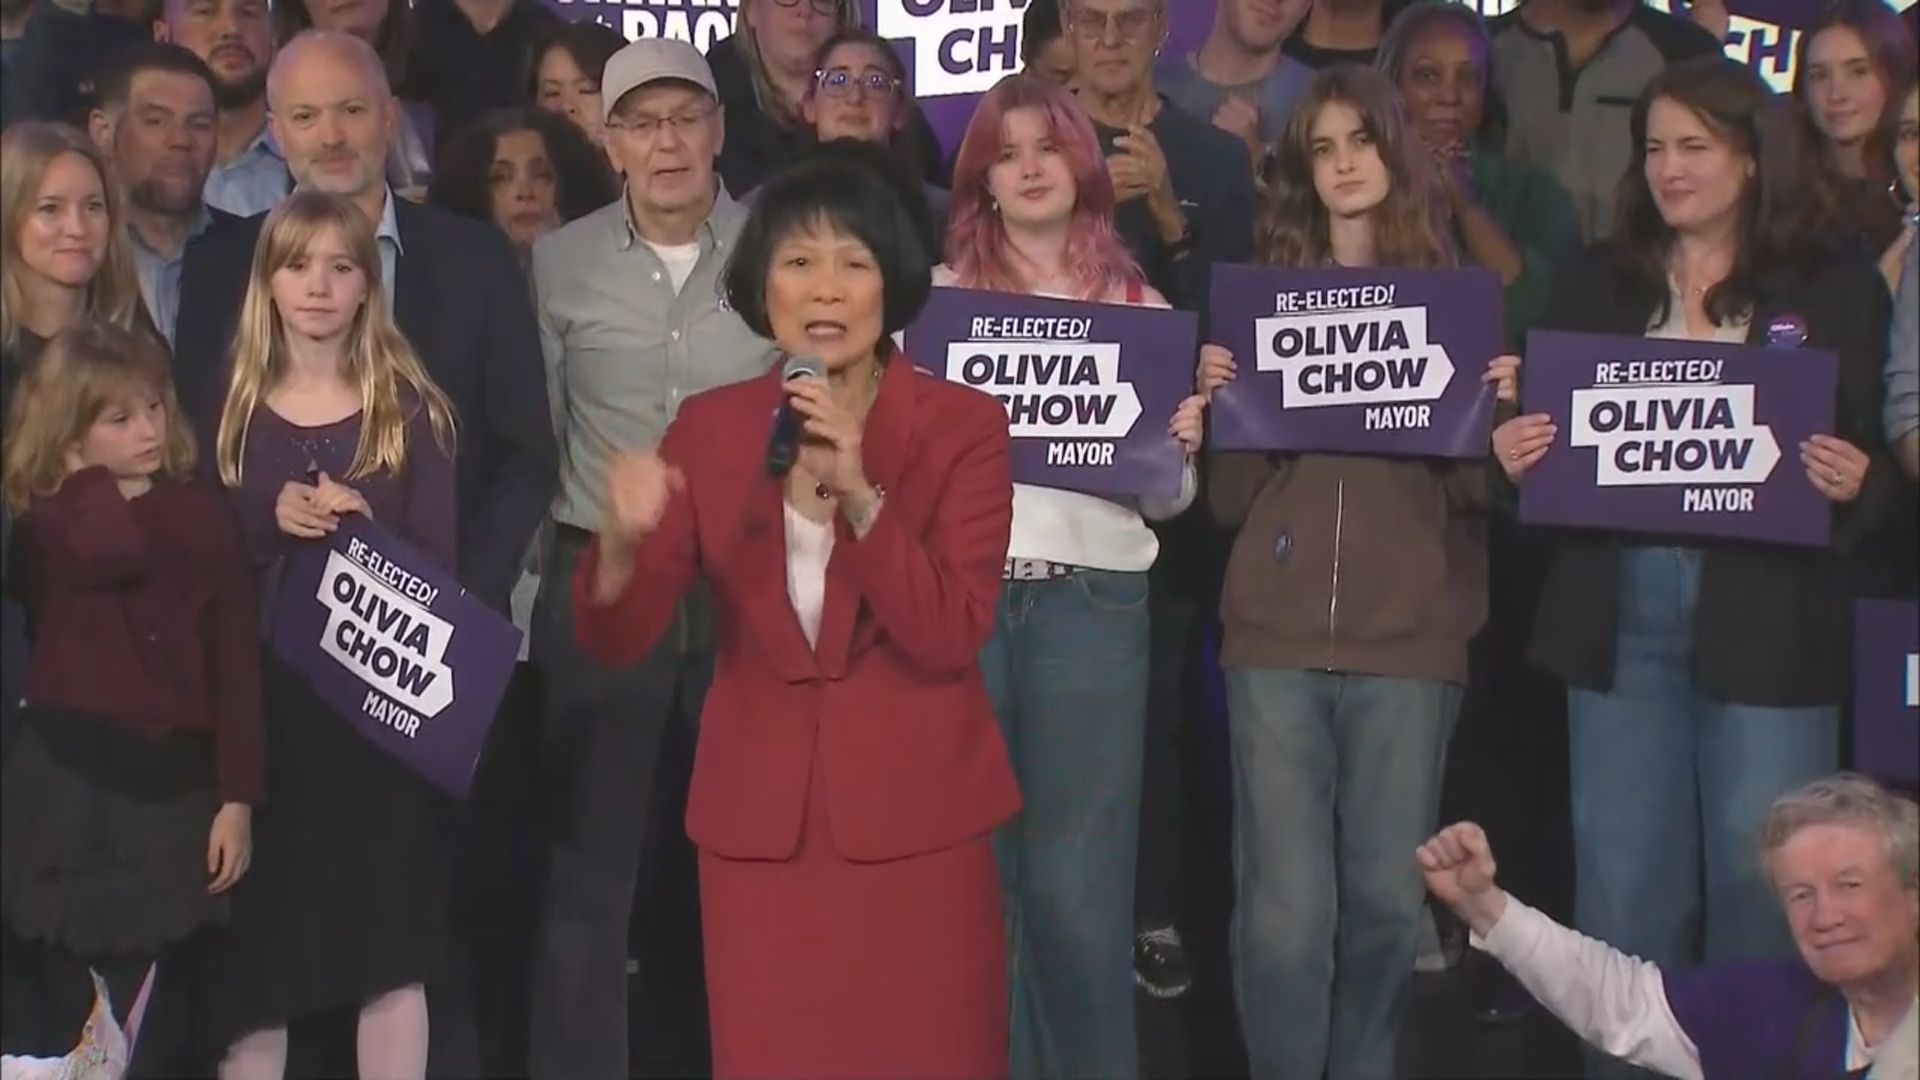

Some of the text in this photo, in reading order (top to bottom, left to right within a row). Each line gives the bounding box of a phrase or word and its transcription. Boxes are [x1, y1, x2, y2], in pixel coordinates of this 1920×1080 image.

[1276, 284, 1395, 311] RE-ELECTED!
[971, 317, 1092, 338] RE-ELECTED!
[1272, 320, 1409, 358] OLIVIA
[962, 354, 1100, 385] OLIVIA
[1298, 357, 1428, 395] CHOW
[1596, 360, 1723, 383] RE-ELECTED!
[1365, 405, 1430, 430] MAYOR
[1589, 398, 1735, 433] OLIVIA
[1047, 442, 1115, 465] MAYOR
[1614, 438, 1754, 473] CHOW
[1683, 489, 1754, 512] MAYOR
[349, 537, 439, 606] RE-ELECTED!
[333, 572, 431, 657] OLIVIA
[336, 619, 437, 697] CHOW
[362, 690, 421, 738] MAYOR
